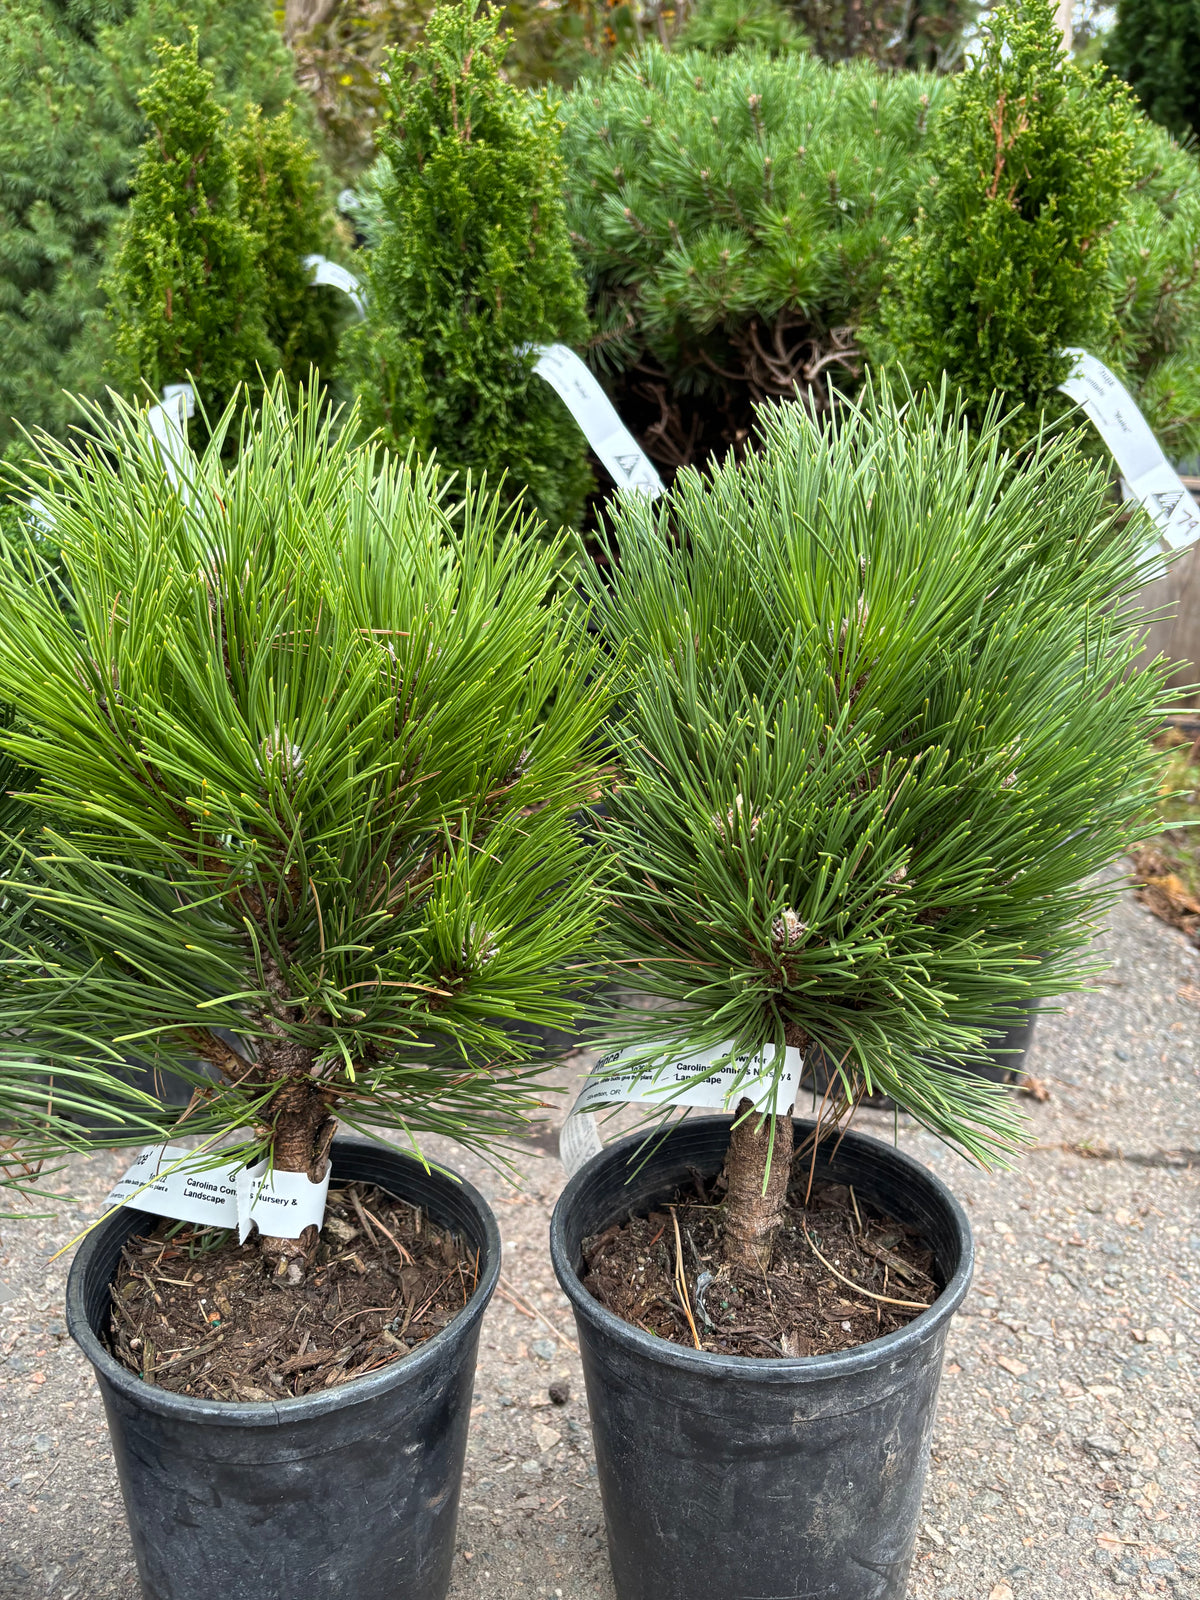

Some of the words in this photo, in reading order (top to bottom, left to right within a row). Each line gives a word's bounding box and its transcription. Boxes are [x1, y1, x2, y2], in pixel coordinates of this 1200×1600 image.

[1177, 508, 1199, 536] 79
[675, 1073, 722, 1085] Lanape
[786, 1073, 792, 1081] &
[183, 1187, 226, 1205] Landscape
[186, 1177, 218, 1192] Carolina
[291, 1198, 298, 1206] &
